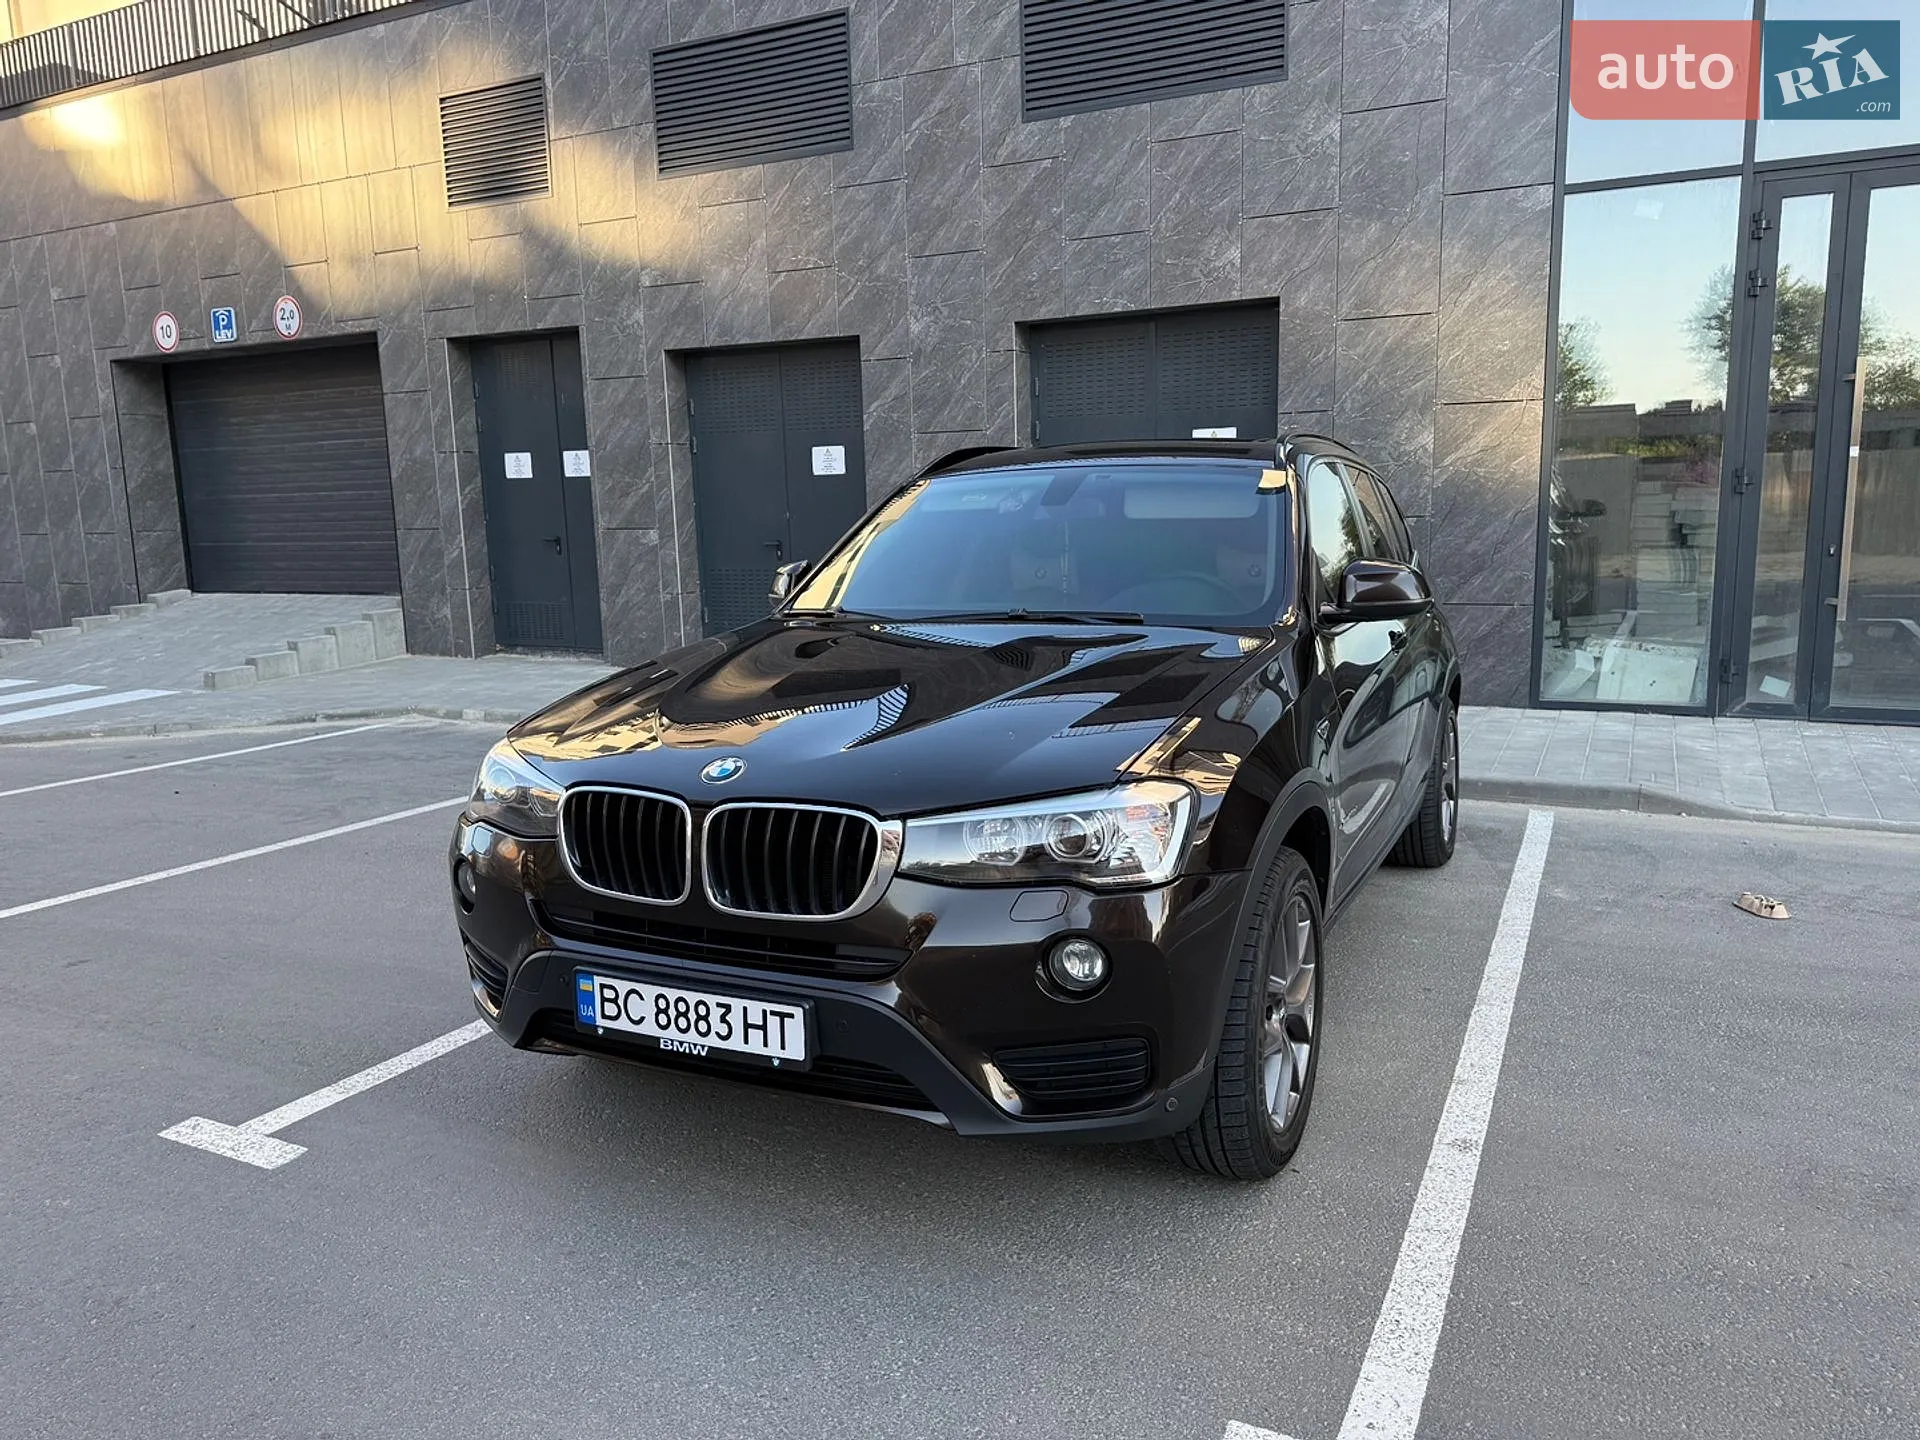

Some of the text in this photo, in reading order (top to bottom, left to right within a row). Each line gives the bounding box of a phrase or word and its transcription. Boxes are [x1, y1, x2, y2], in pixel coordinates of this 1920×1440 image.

[218, 314, 228, 330] P
[159, 324, 172, 339] 10
[215, 329, 232, 339] LEV
[580, 1004, 594, 1017] UA
[599, 982, 795, 1051] BC 8883 HT
[659, 1038, 709, 1057] BMW
